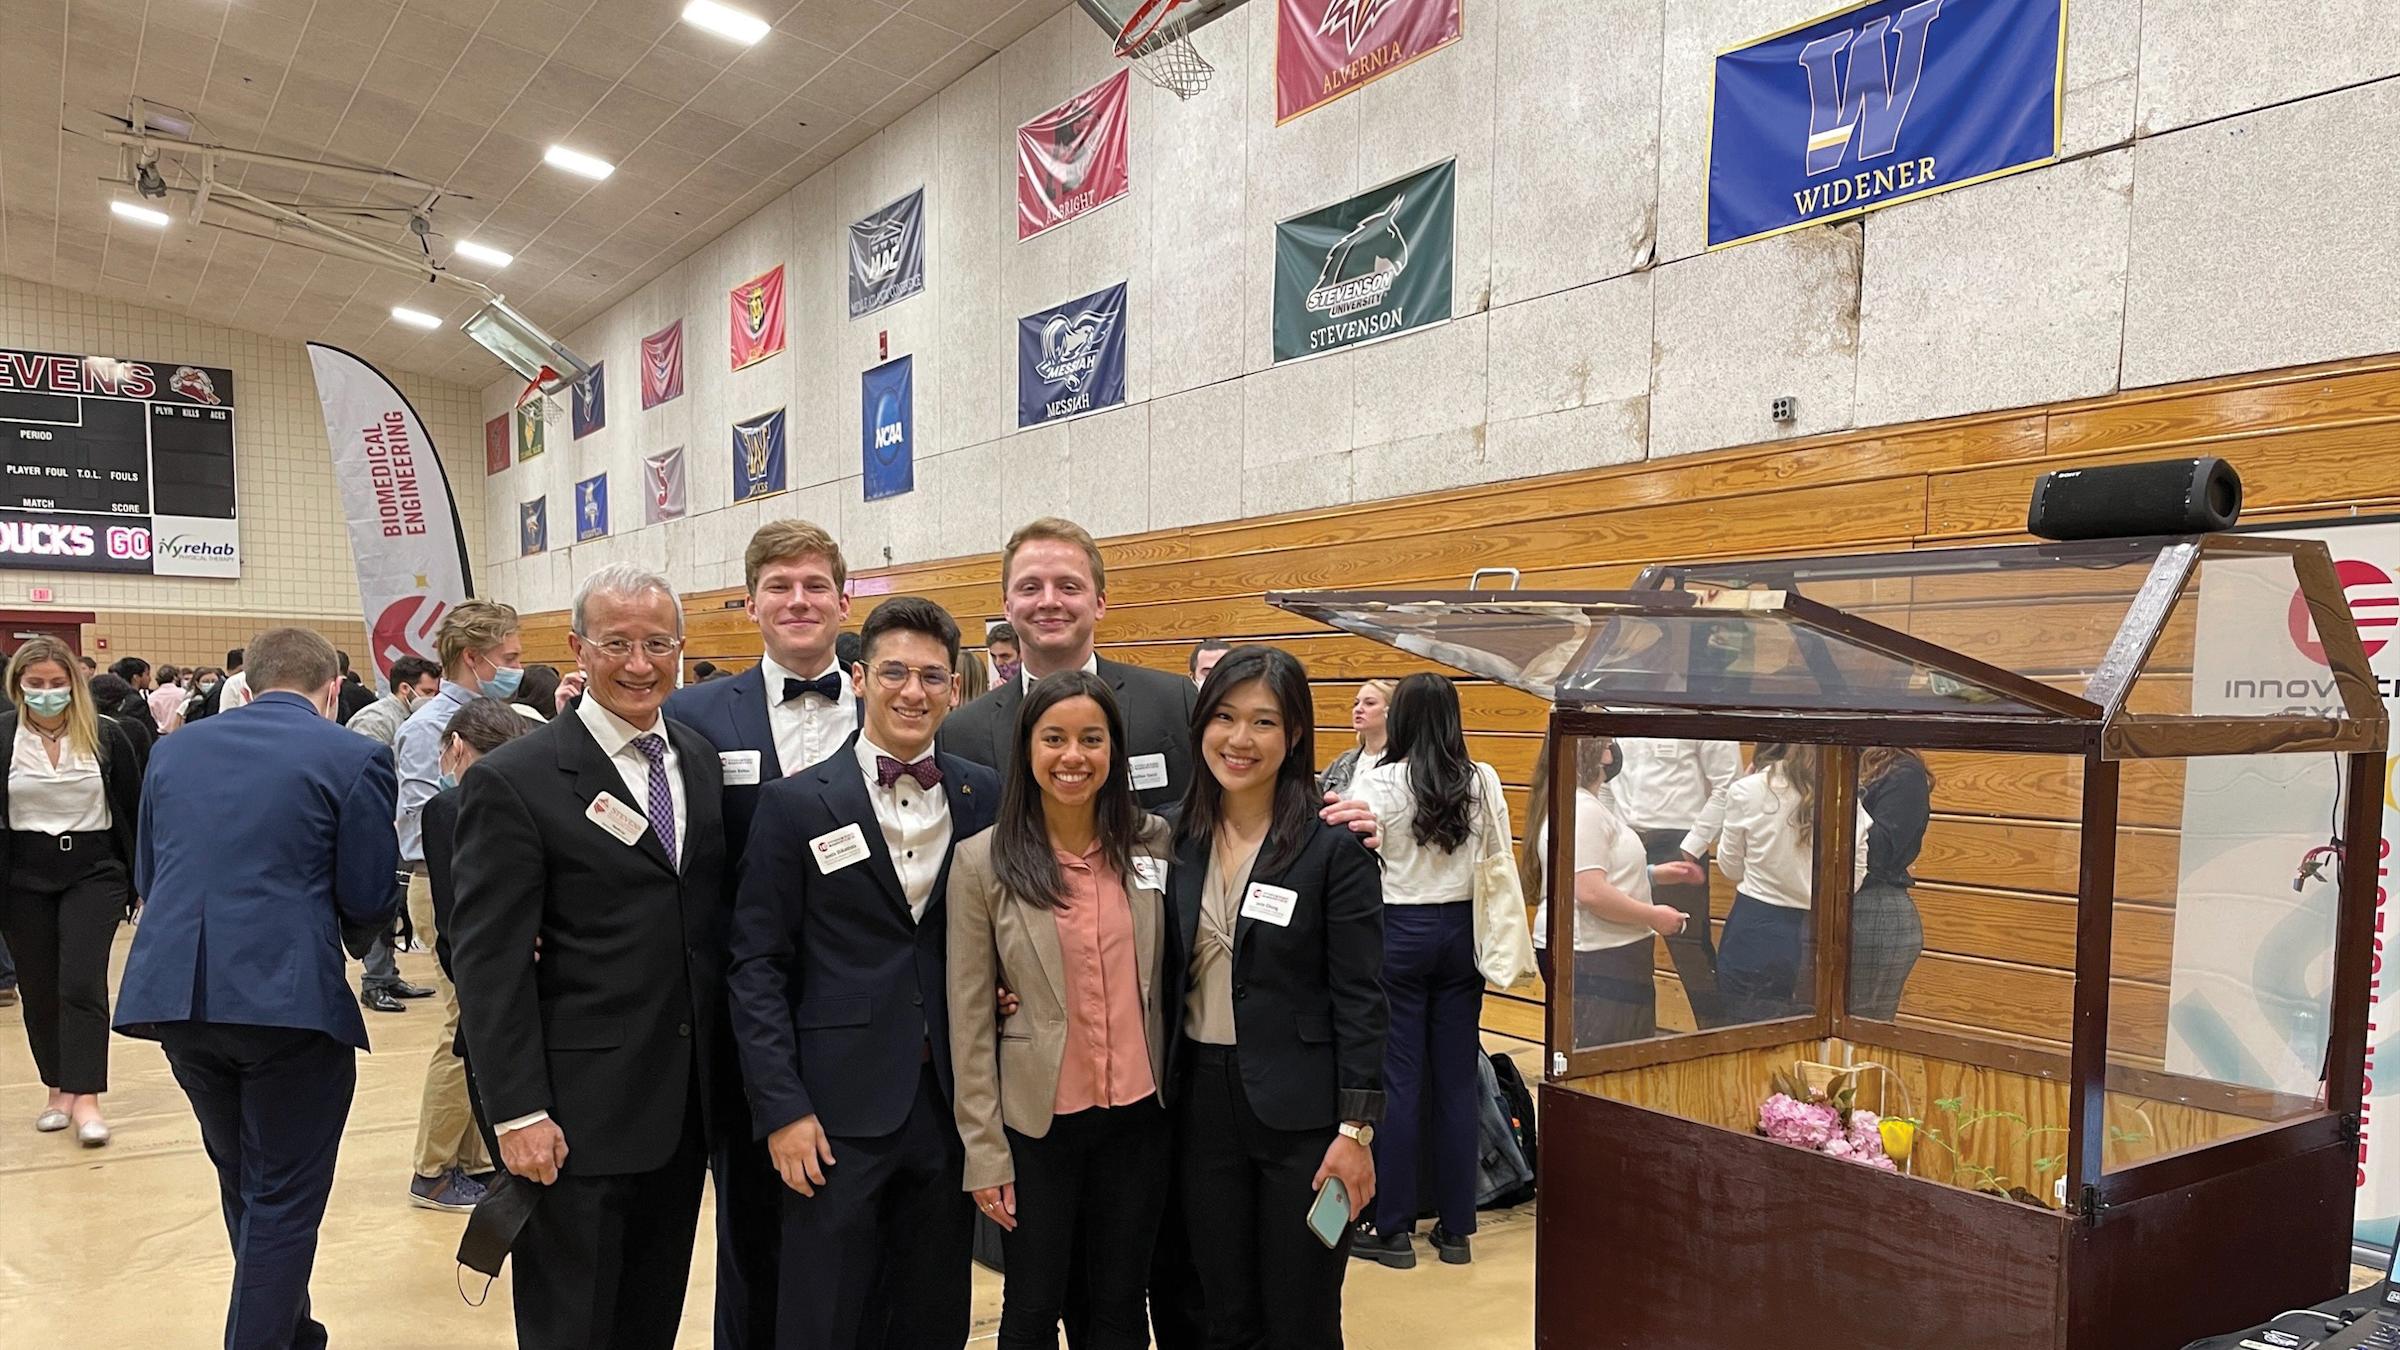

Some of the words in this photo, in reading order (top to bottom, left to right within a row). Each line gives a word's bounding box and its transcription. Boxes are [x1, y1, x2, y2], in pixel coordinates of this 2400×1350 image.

[1323, 41, 1403, 94] ALVERNIA
[1793, 156, 1936, 215] WIDENER
[869, 244, 900, 280] MAC
[1306, 271, 1392, 311] STEVENSON
[1331, 293, 1382, 316] UNIVERSITY
[1310, 308, 1404, 350] STEVENSON
[1046, 354, 1096, 380] MESSIAH
[155, 406, 174, 417] PLYR
[182, 407, 200, 418] KILLS
[210, 410, 226, 420] ACES
[1045, 393, 1090, 418] MESSIAH
[20, 430, 52, 441] PERIOD
[875, 422, 903, 450] NCAA
[7, 465, 41, 476] PLAYER
[45, 467, 69, 478] FOUL
[76, 469, 101, 479] T.O.L.
[110, 471, 138, 482] FOULS
[363, 423, 401, 537] BIOMEDICAL
[384, 411, 426, 536] ENGINEERING
[23, 498, 54, 509] MATCH
[112, 503, 140, 513] SCORE
[106, 525, 151, 560] GO
